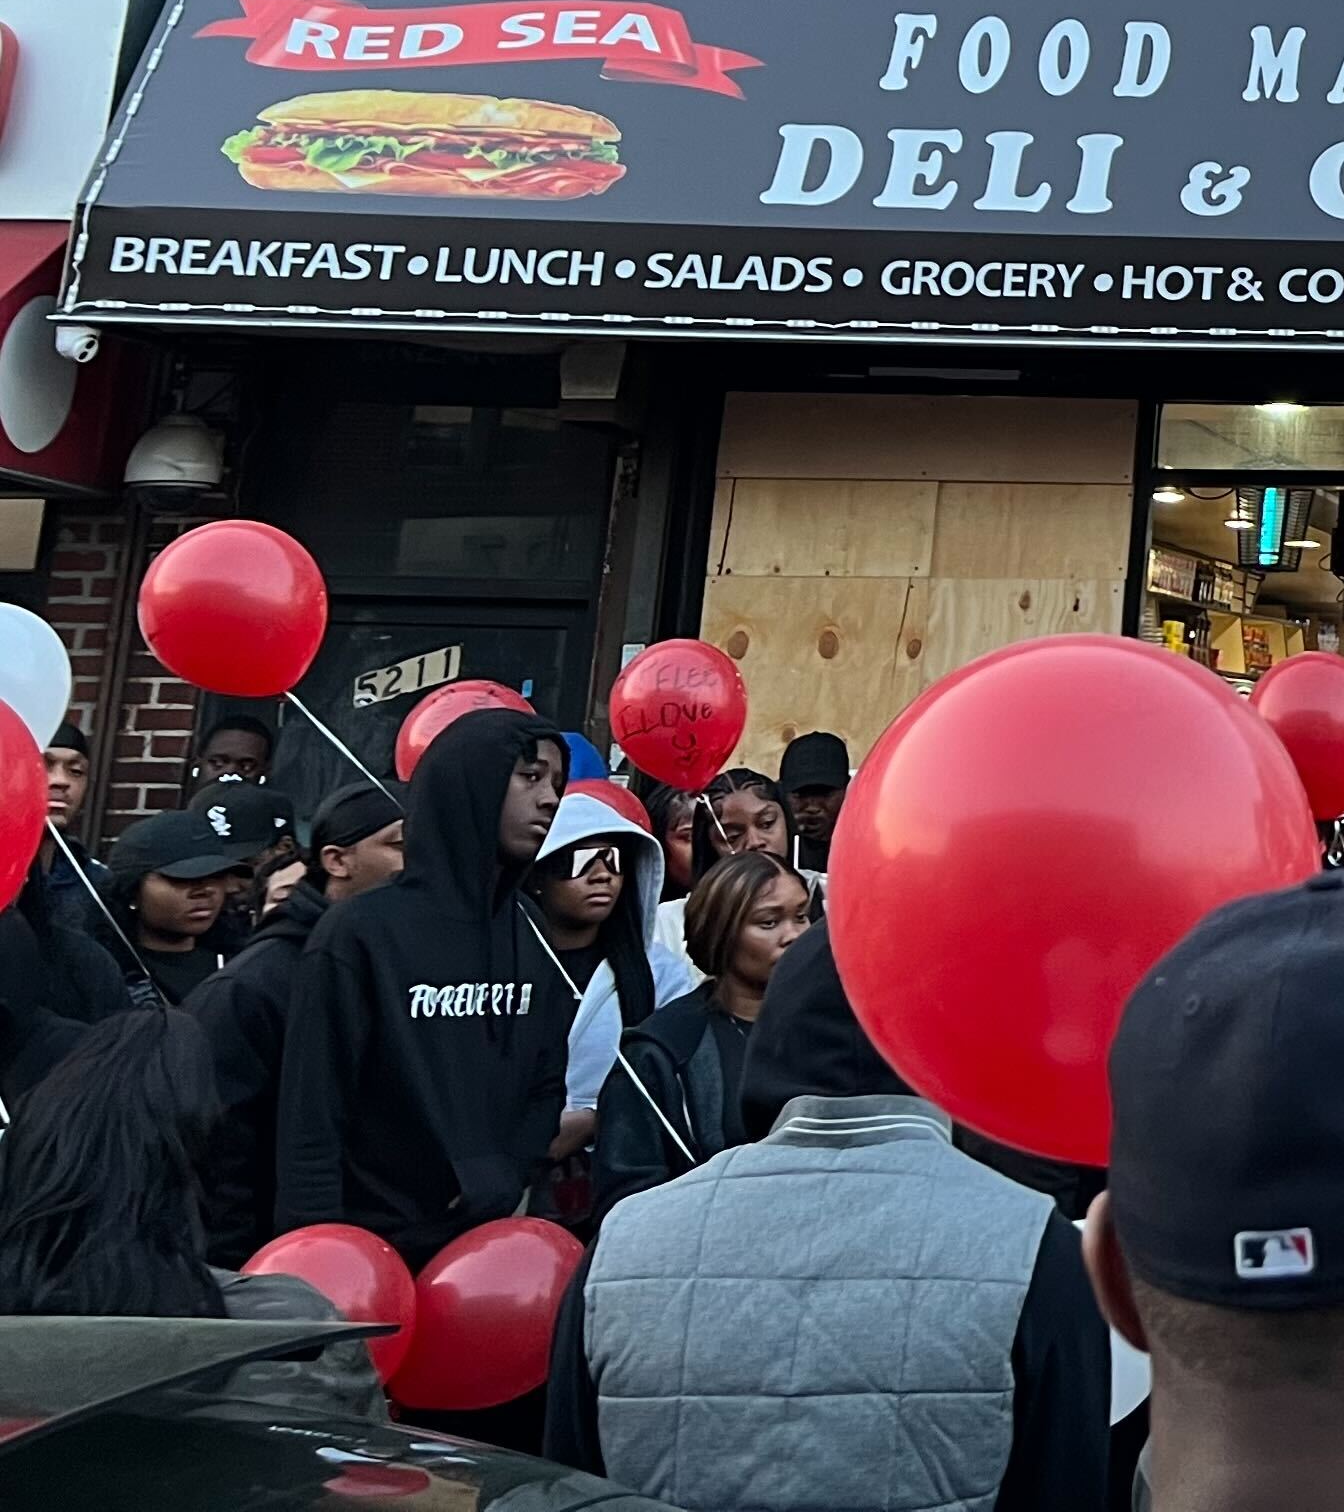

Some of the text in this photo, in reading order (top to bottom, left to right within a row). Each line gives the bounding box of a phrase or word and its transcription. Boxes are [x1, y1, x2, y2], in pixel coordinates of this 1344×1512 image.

[285, 10, 661, 60] RED SEA
[879, 14, 1172, 97] FOOD
[759, 124, 1124, 214] DELI
[1180, 160, 1252, 216] &
[110, 237, 405, 280] BREAKFAST
[434, 247, 604, 287] LUNCH
[643, 253, 833, 293] SALADS
[881, 260, 1085, 298] GROCERY
[1122, 265, 1223, 301] HOT
[1226, 267, 1264, 302] &
[356, 648, 452, 704] 5211
